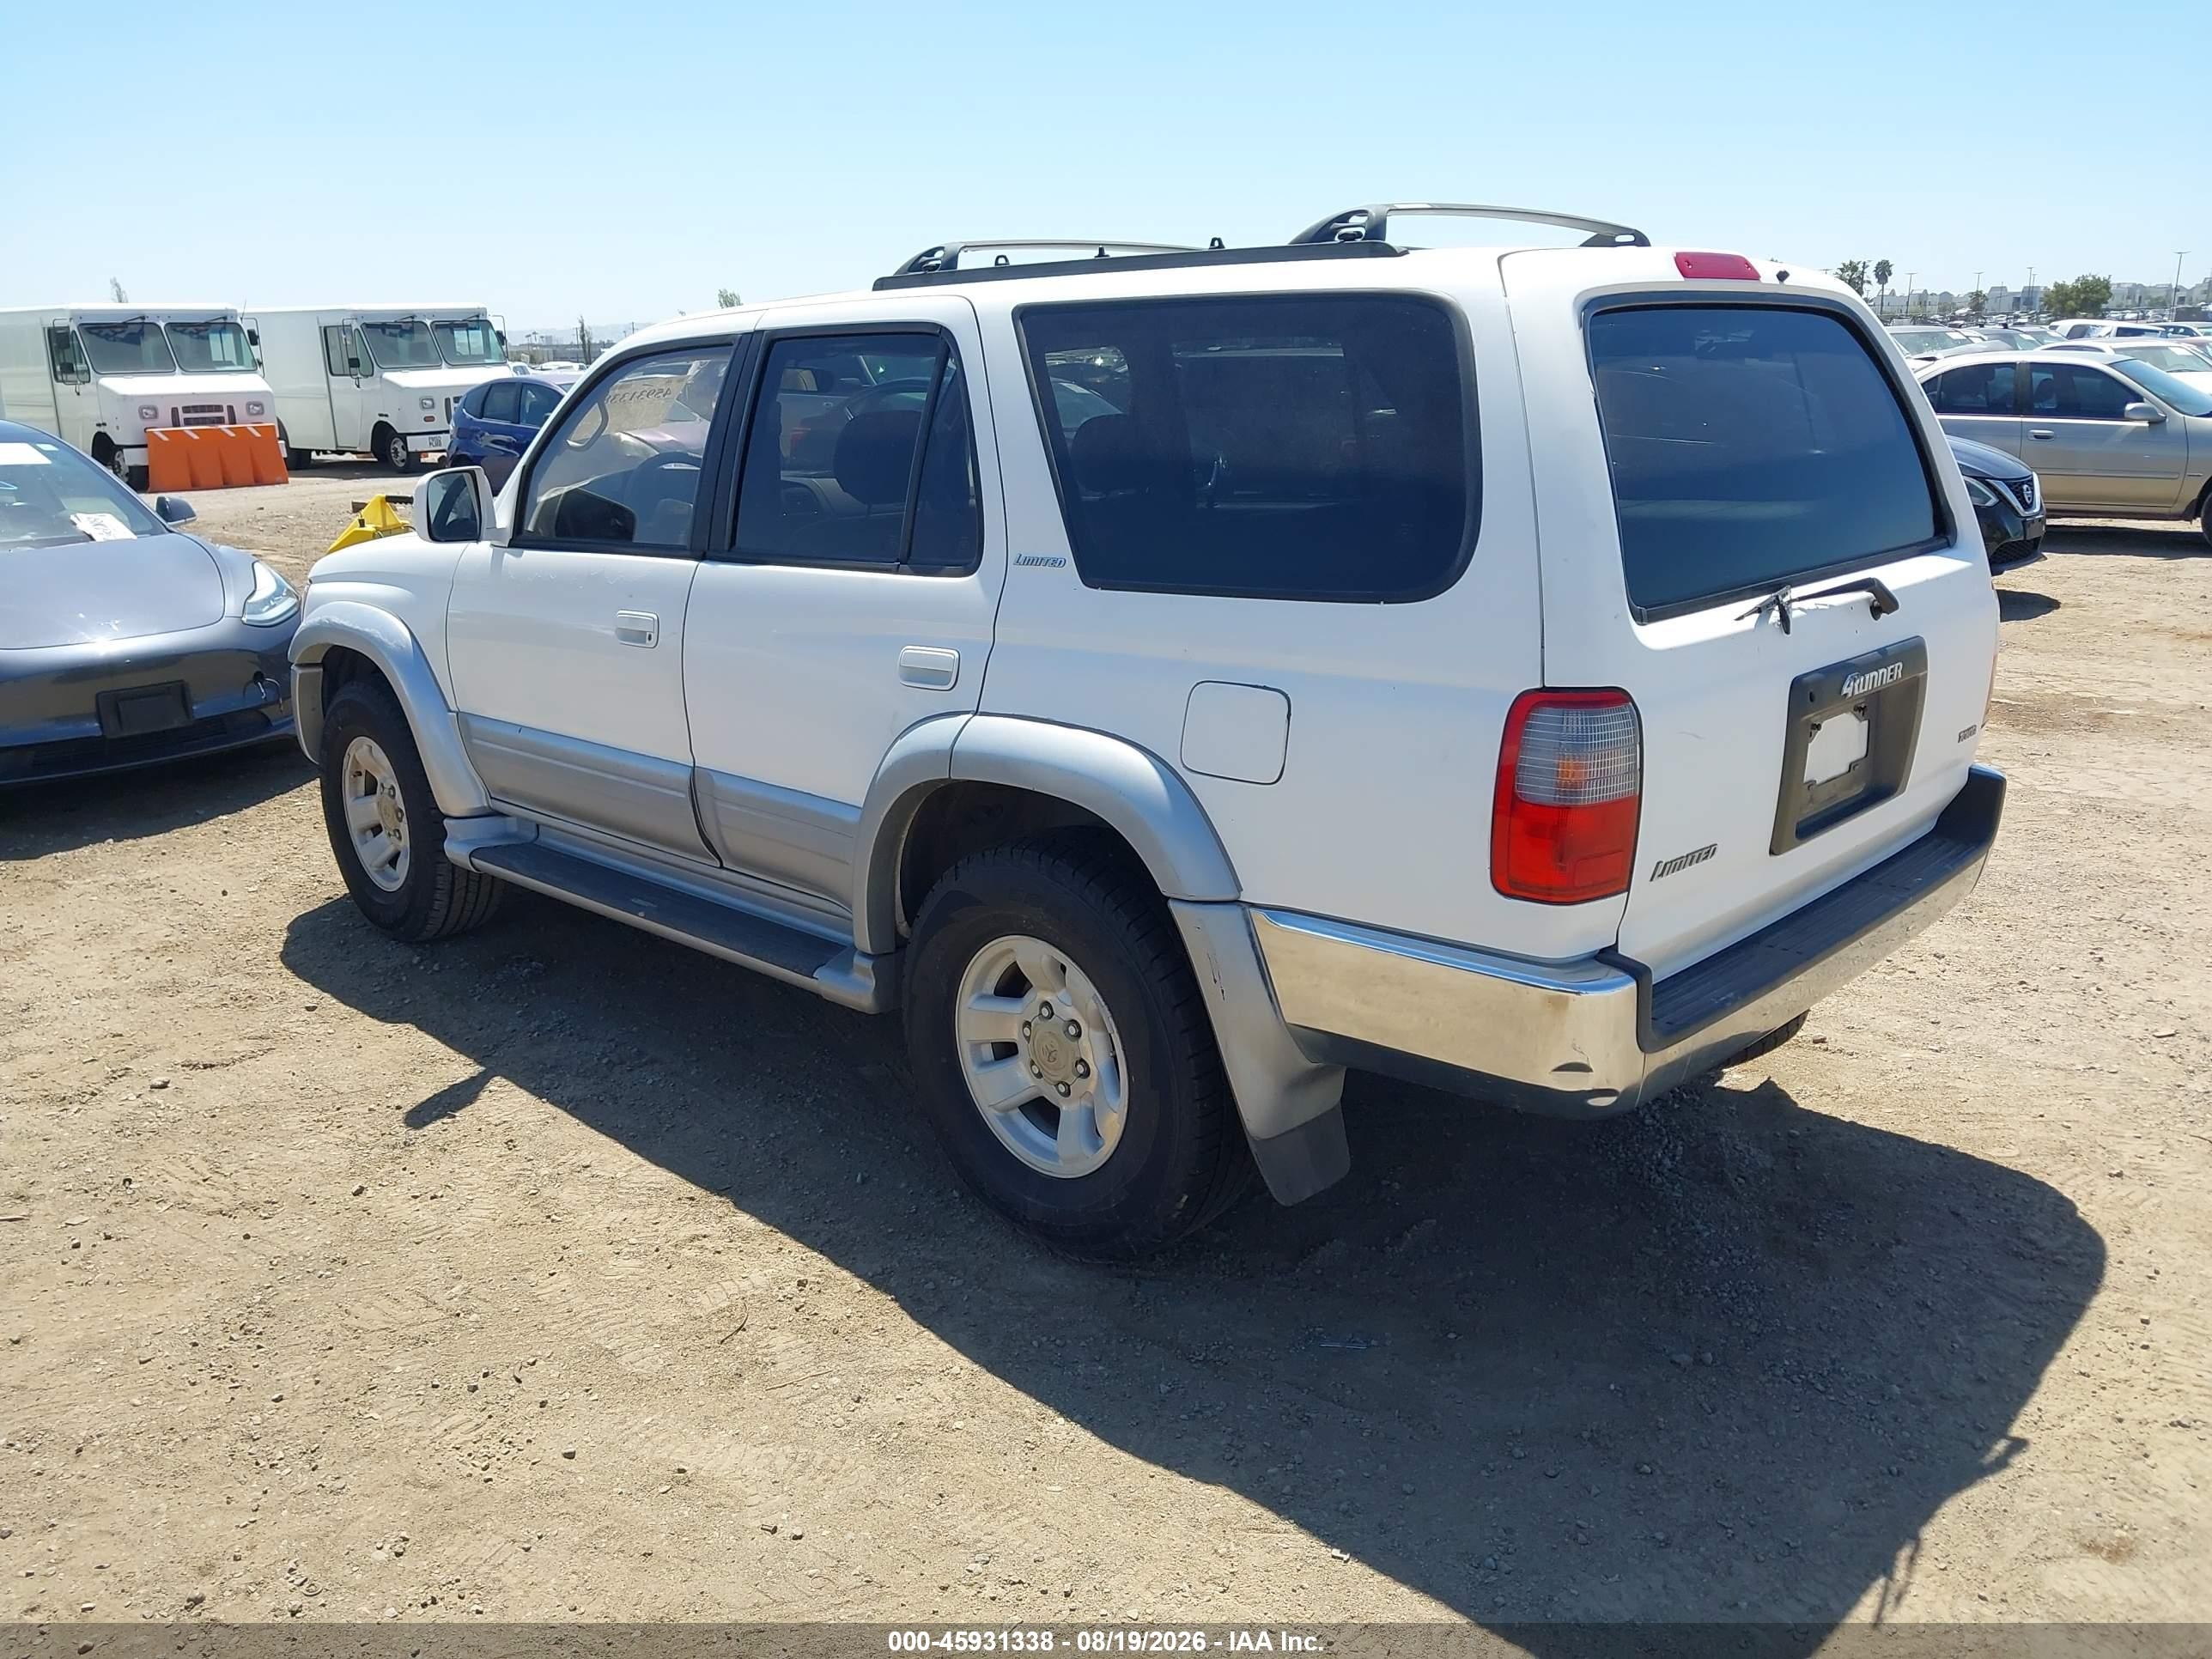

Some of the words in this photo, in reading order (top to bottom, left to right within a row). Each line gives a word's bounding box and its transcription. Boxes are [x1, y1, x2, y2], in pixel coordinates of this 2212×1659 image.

[1013, 553, 1066, 568] LIMITED
[1840, 661, 1904, 700] 4RUNNER
[1649, 842, 1718, 883] LIMITED
